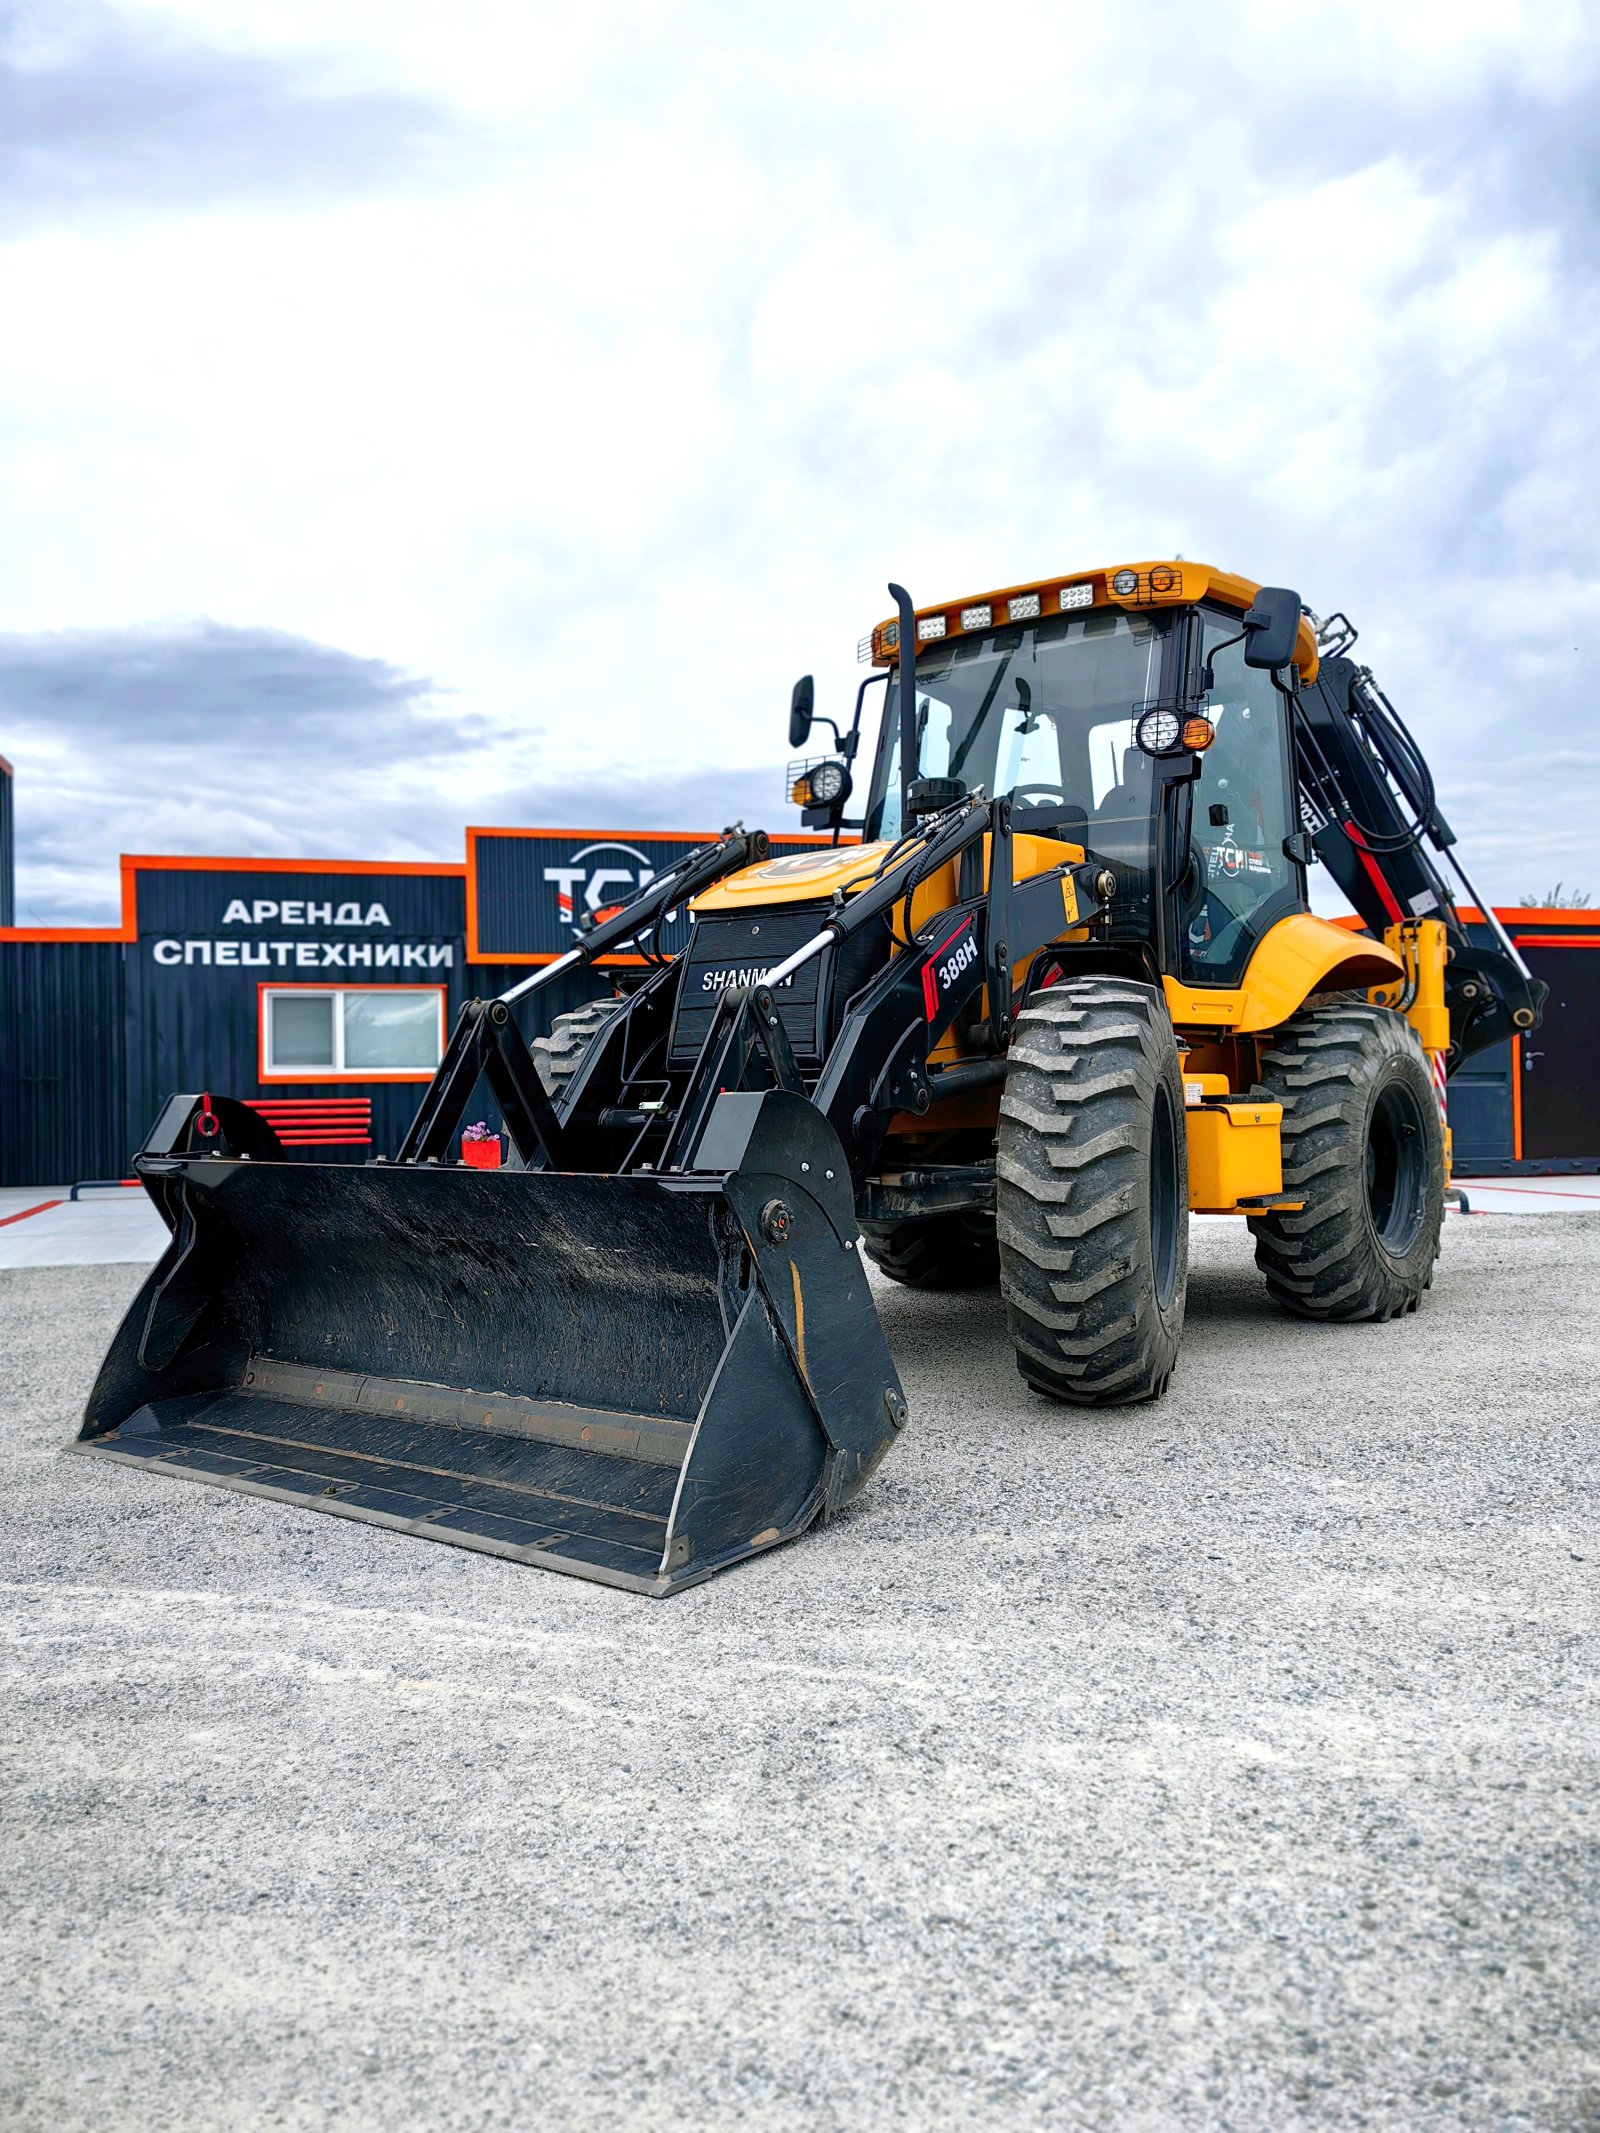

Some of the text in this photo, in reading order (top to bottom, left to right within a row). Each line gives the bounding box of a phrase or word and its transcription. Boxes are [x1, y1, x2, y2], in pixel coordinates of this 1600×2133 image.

[222, 900, 391, 926] АРЕНДА
[153, 940, 454, 968] СПЕЦТЕХНИКИ
[938, 935, 979, 990] 388H
[702, 967, 792, 991] SHANMN
